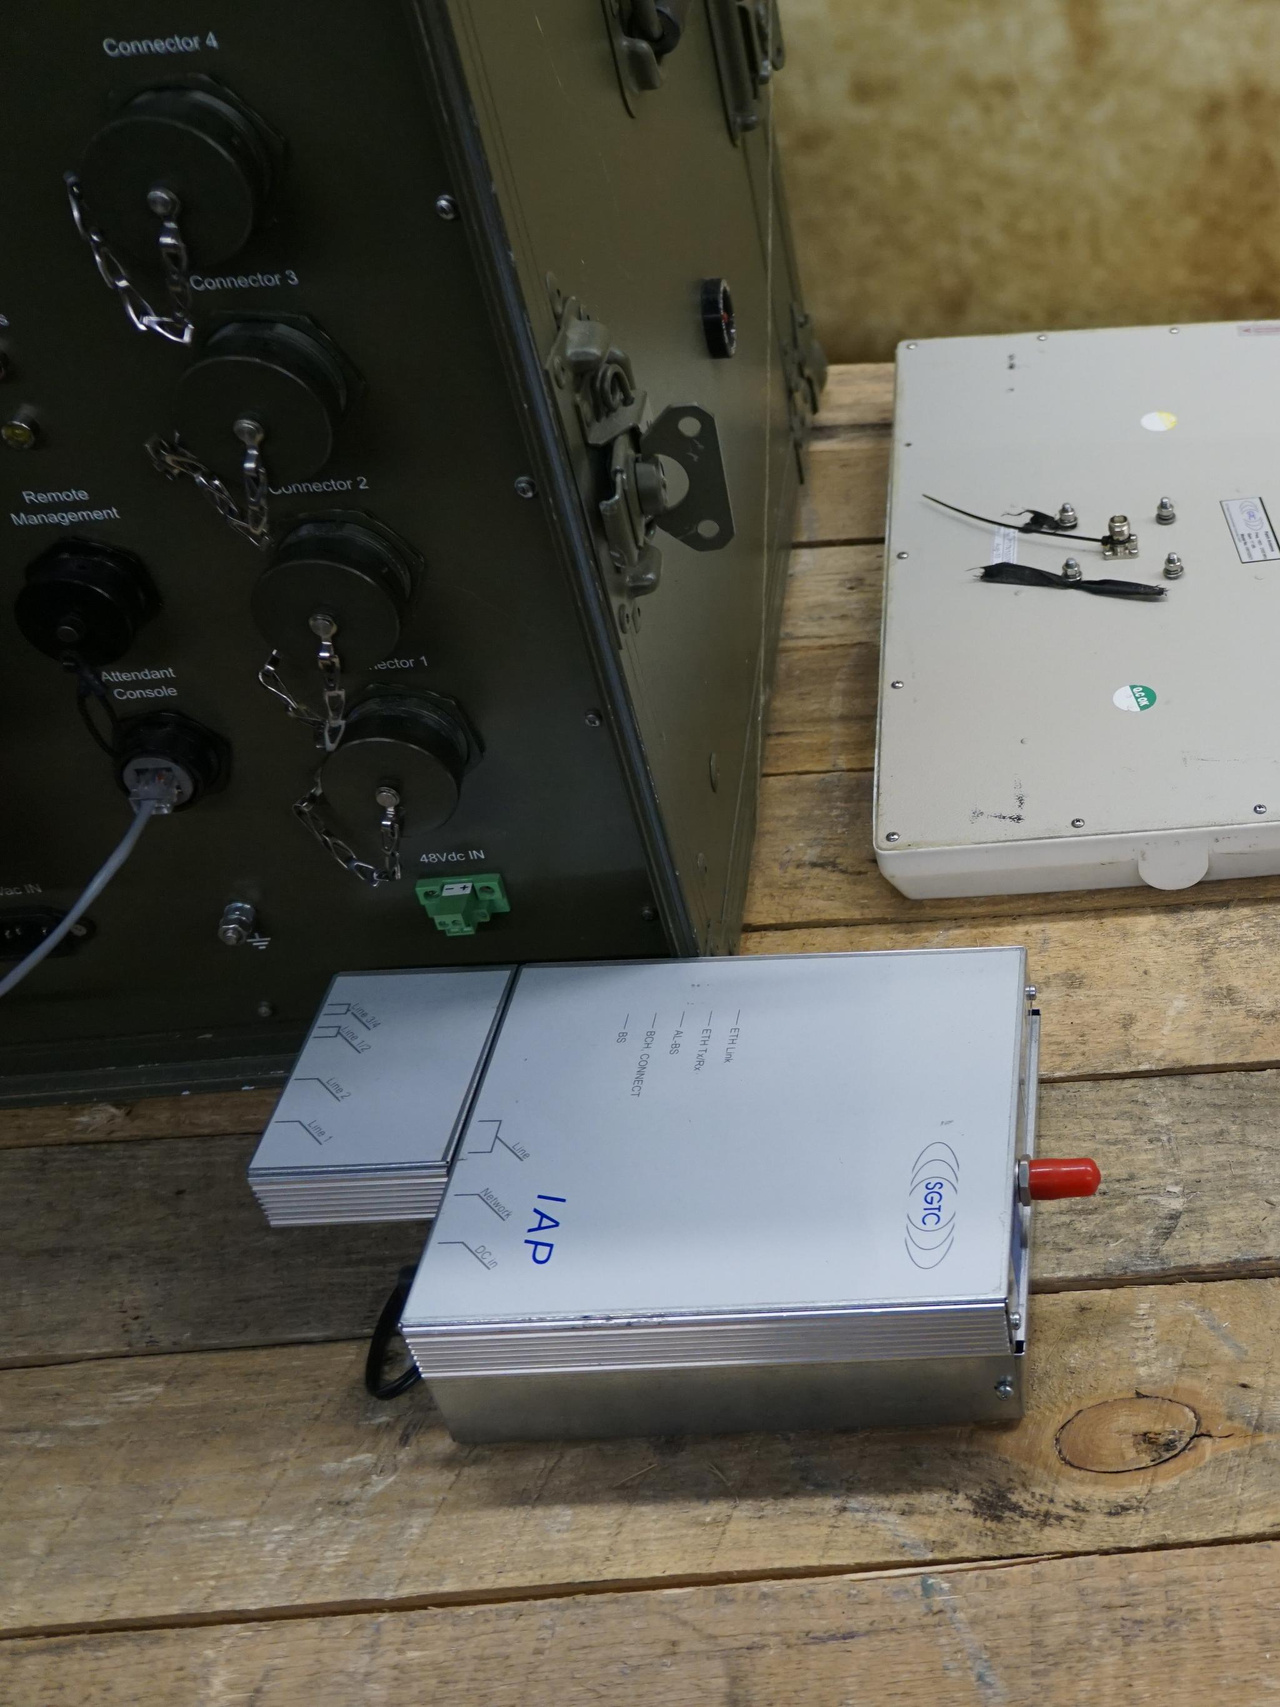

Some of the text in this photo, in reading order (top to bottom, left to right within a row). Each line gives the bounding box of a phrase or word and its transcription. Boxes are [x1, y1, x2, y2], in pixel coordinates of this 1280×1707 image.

[103, 32, 219, 57] Connector 4
[189, 270, 299, 291] Connector 3
[356, 476, 369, 489] 2
[22, 488, 90, 504] Remote
[10, 507, 121, 526] Management
[420, 656, 428, 666] 1
[101, 667, 176, 683] Attendant
[113, 686, 178, 700] Console
[420, 850, 485, 864] 48Vdc IN
[24, 883, 43, 894] IN
[352, 1003, 369, 1018] Line
[341, 1025, 358, 1041] Line
[616, 1031, 628, 1044] BS
[669, 1029, 684, 1055] AL-BS
[694, 1028, 712, 1071] ETH Tx/Rx
[724, 1027, 740, 1063] ETH Link
[630, 1053, 650, 1097] CONNECT
[326, 1077, 352, 1100] Line 2
[307, 1120, 326, 1137] Line
[511, 1142, 530, 1160] Line
[480, 1187, 513, 1219] Network
[921, 1181, 944, 1226] SGTC
[524, 1194, 567, 1265] IAP
[474, 1244, 491, 1261] DC
